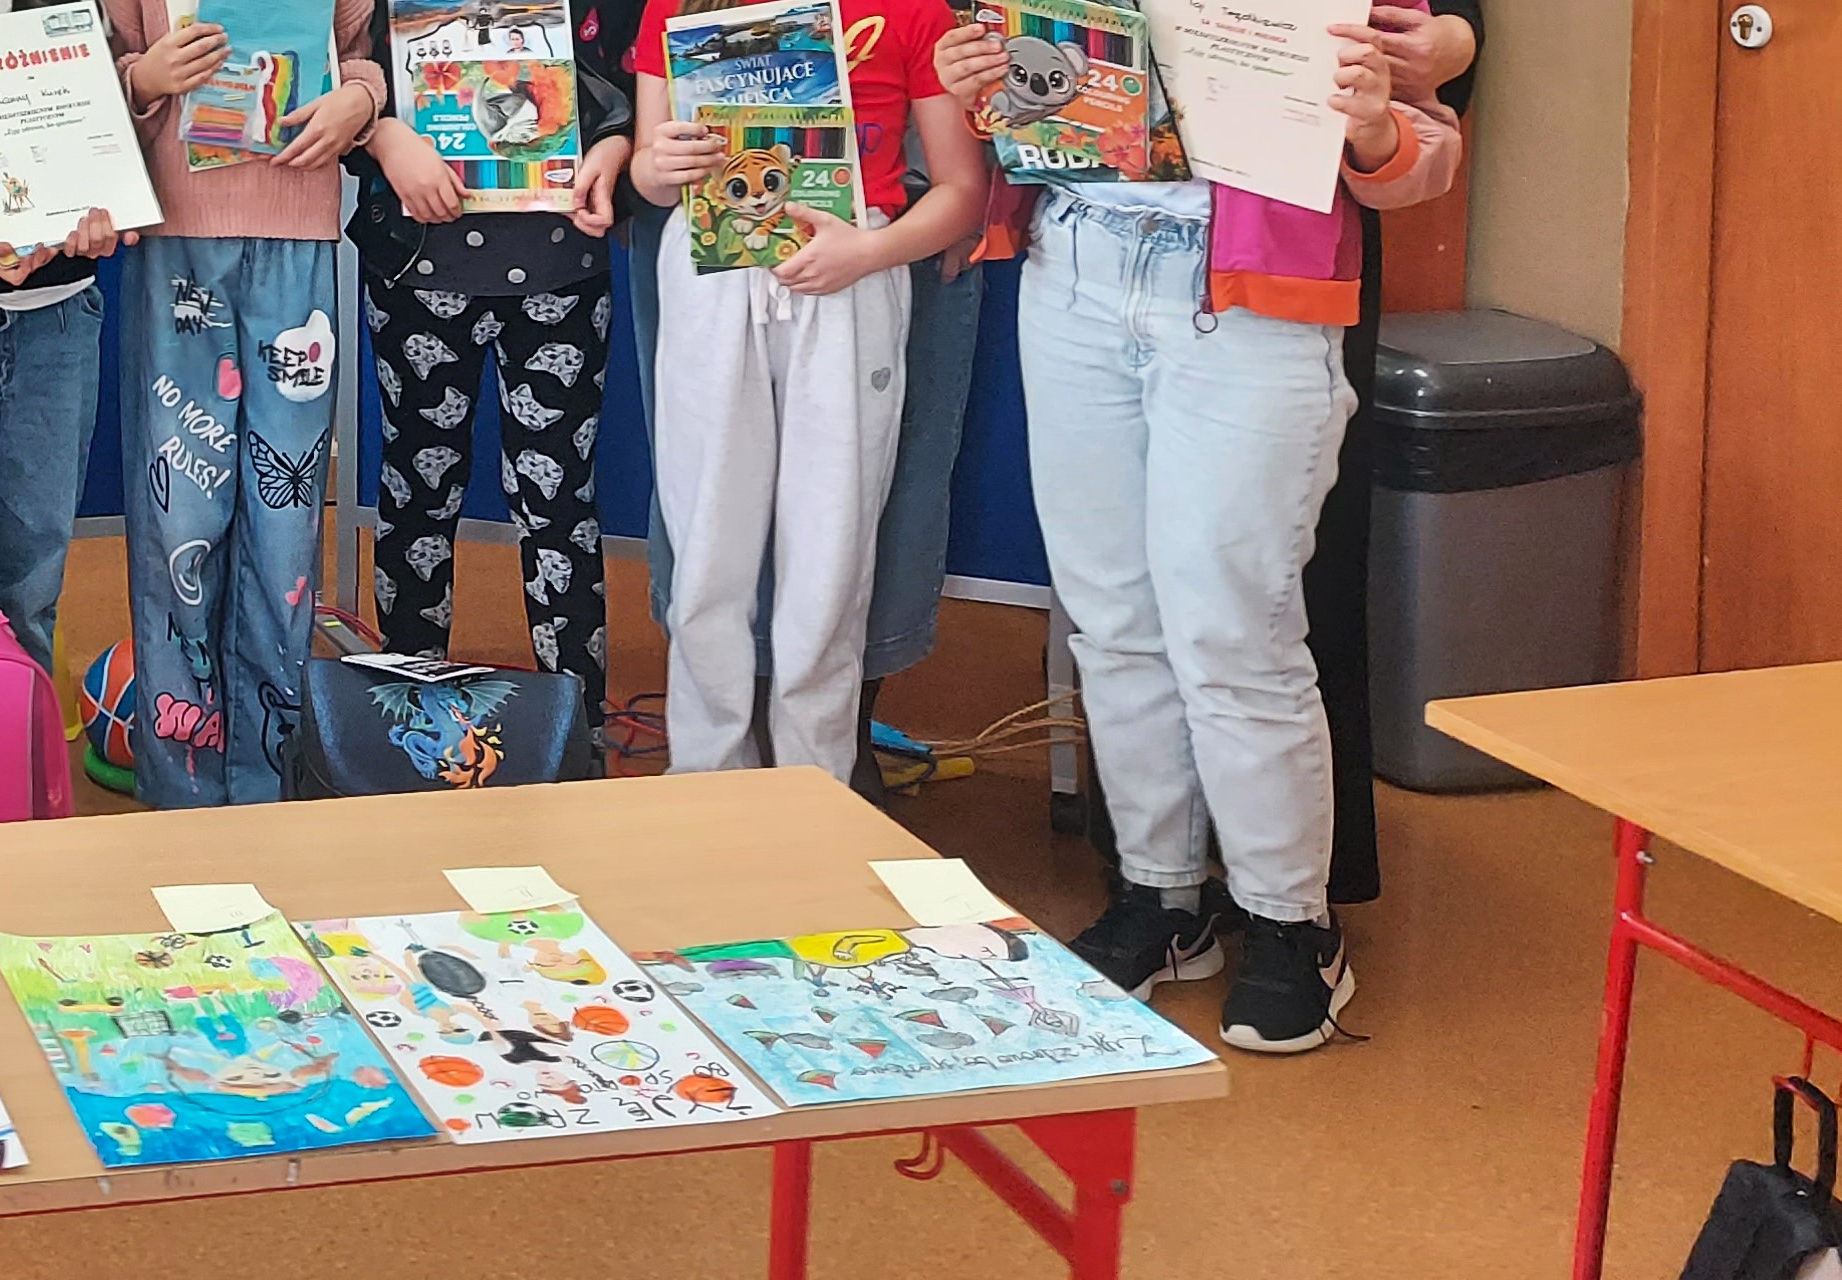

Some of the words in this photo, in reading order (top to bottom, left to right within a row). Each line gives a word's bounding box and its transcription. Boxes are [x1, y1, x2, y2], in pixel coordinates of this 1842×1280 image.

[695, 61, 816, 96] FASCYNUJĄCE
[1088, 70, 1118, 92] 24
[437, 132, 467, 151] 24
[801, 170, 831, 188] 24
[258, 340, 308, 368] KEEP
[152, 374, 181, 408] NO
[177, 400, 238, 453] MORE
[158, 435, 231, 499] RULES!
